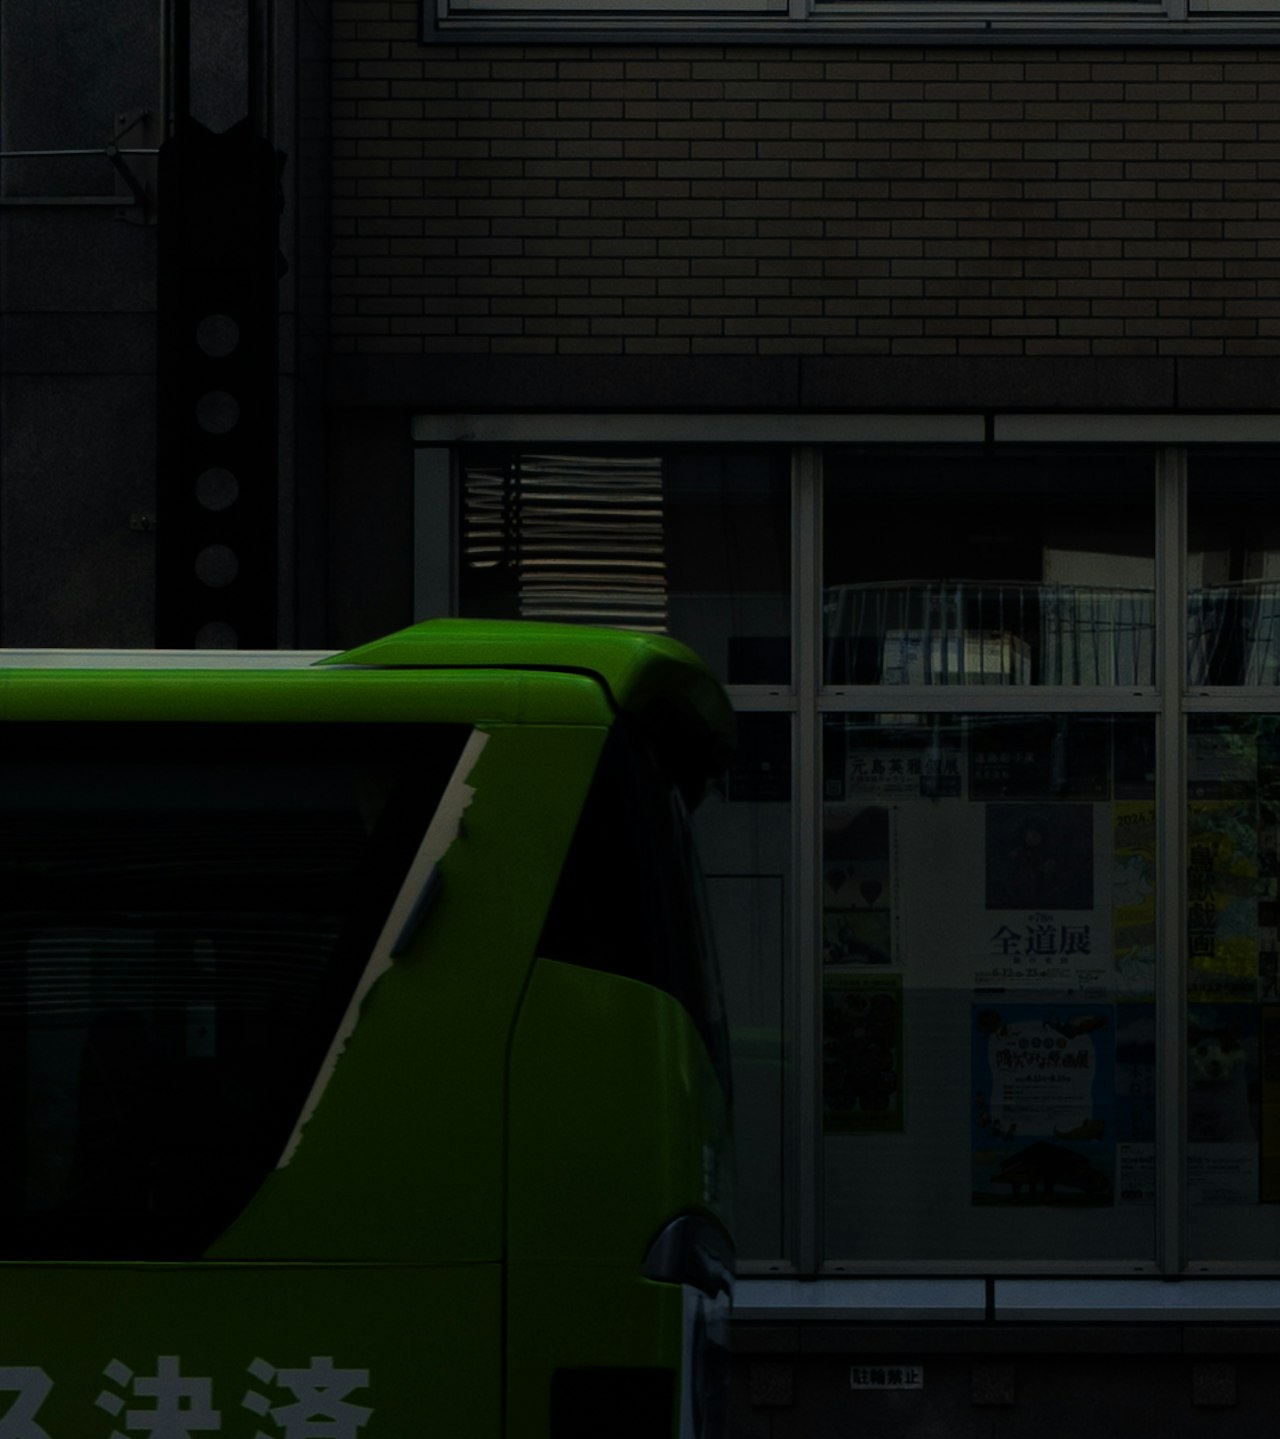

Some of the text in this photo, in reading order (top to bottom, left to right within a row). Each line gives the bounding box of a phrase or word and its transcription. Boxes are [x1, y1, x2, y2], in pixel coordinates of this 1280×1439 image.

[991, 924, 1091, 956] 全道展
[853, 1368, 920, 1385] 駐輪禁止
